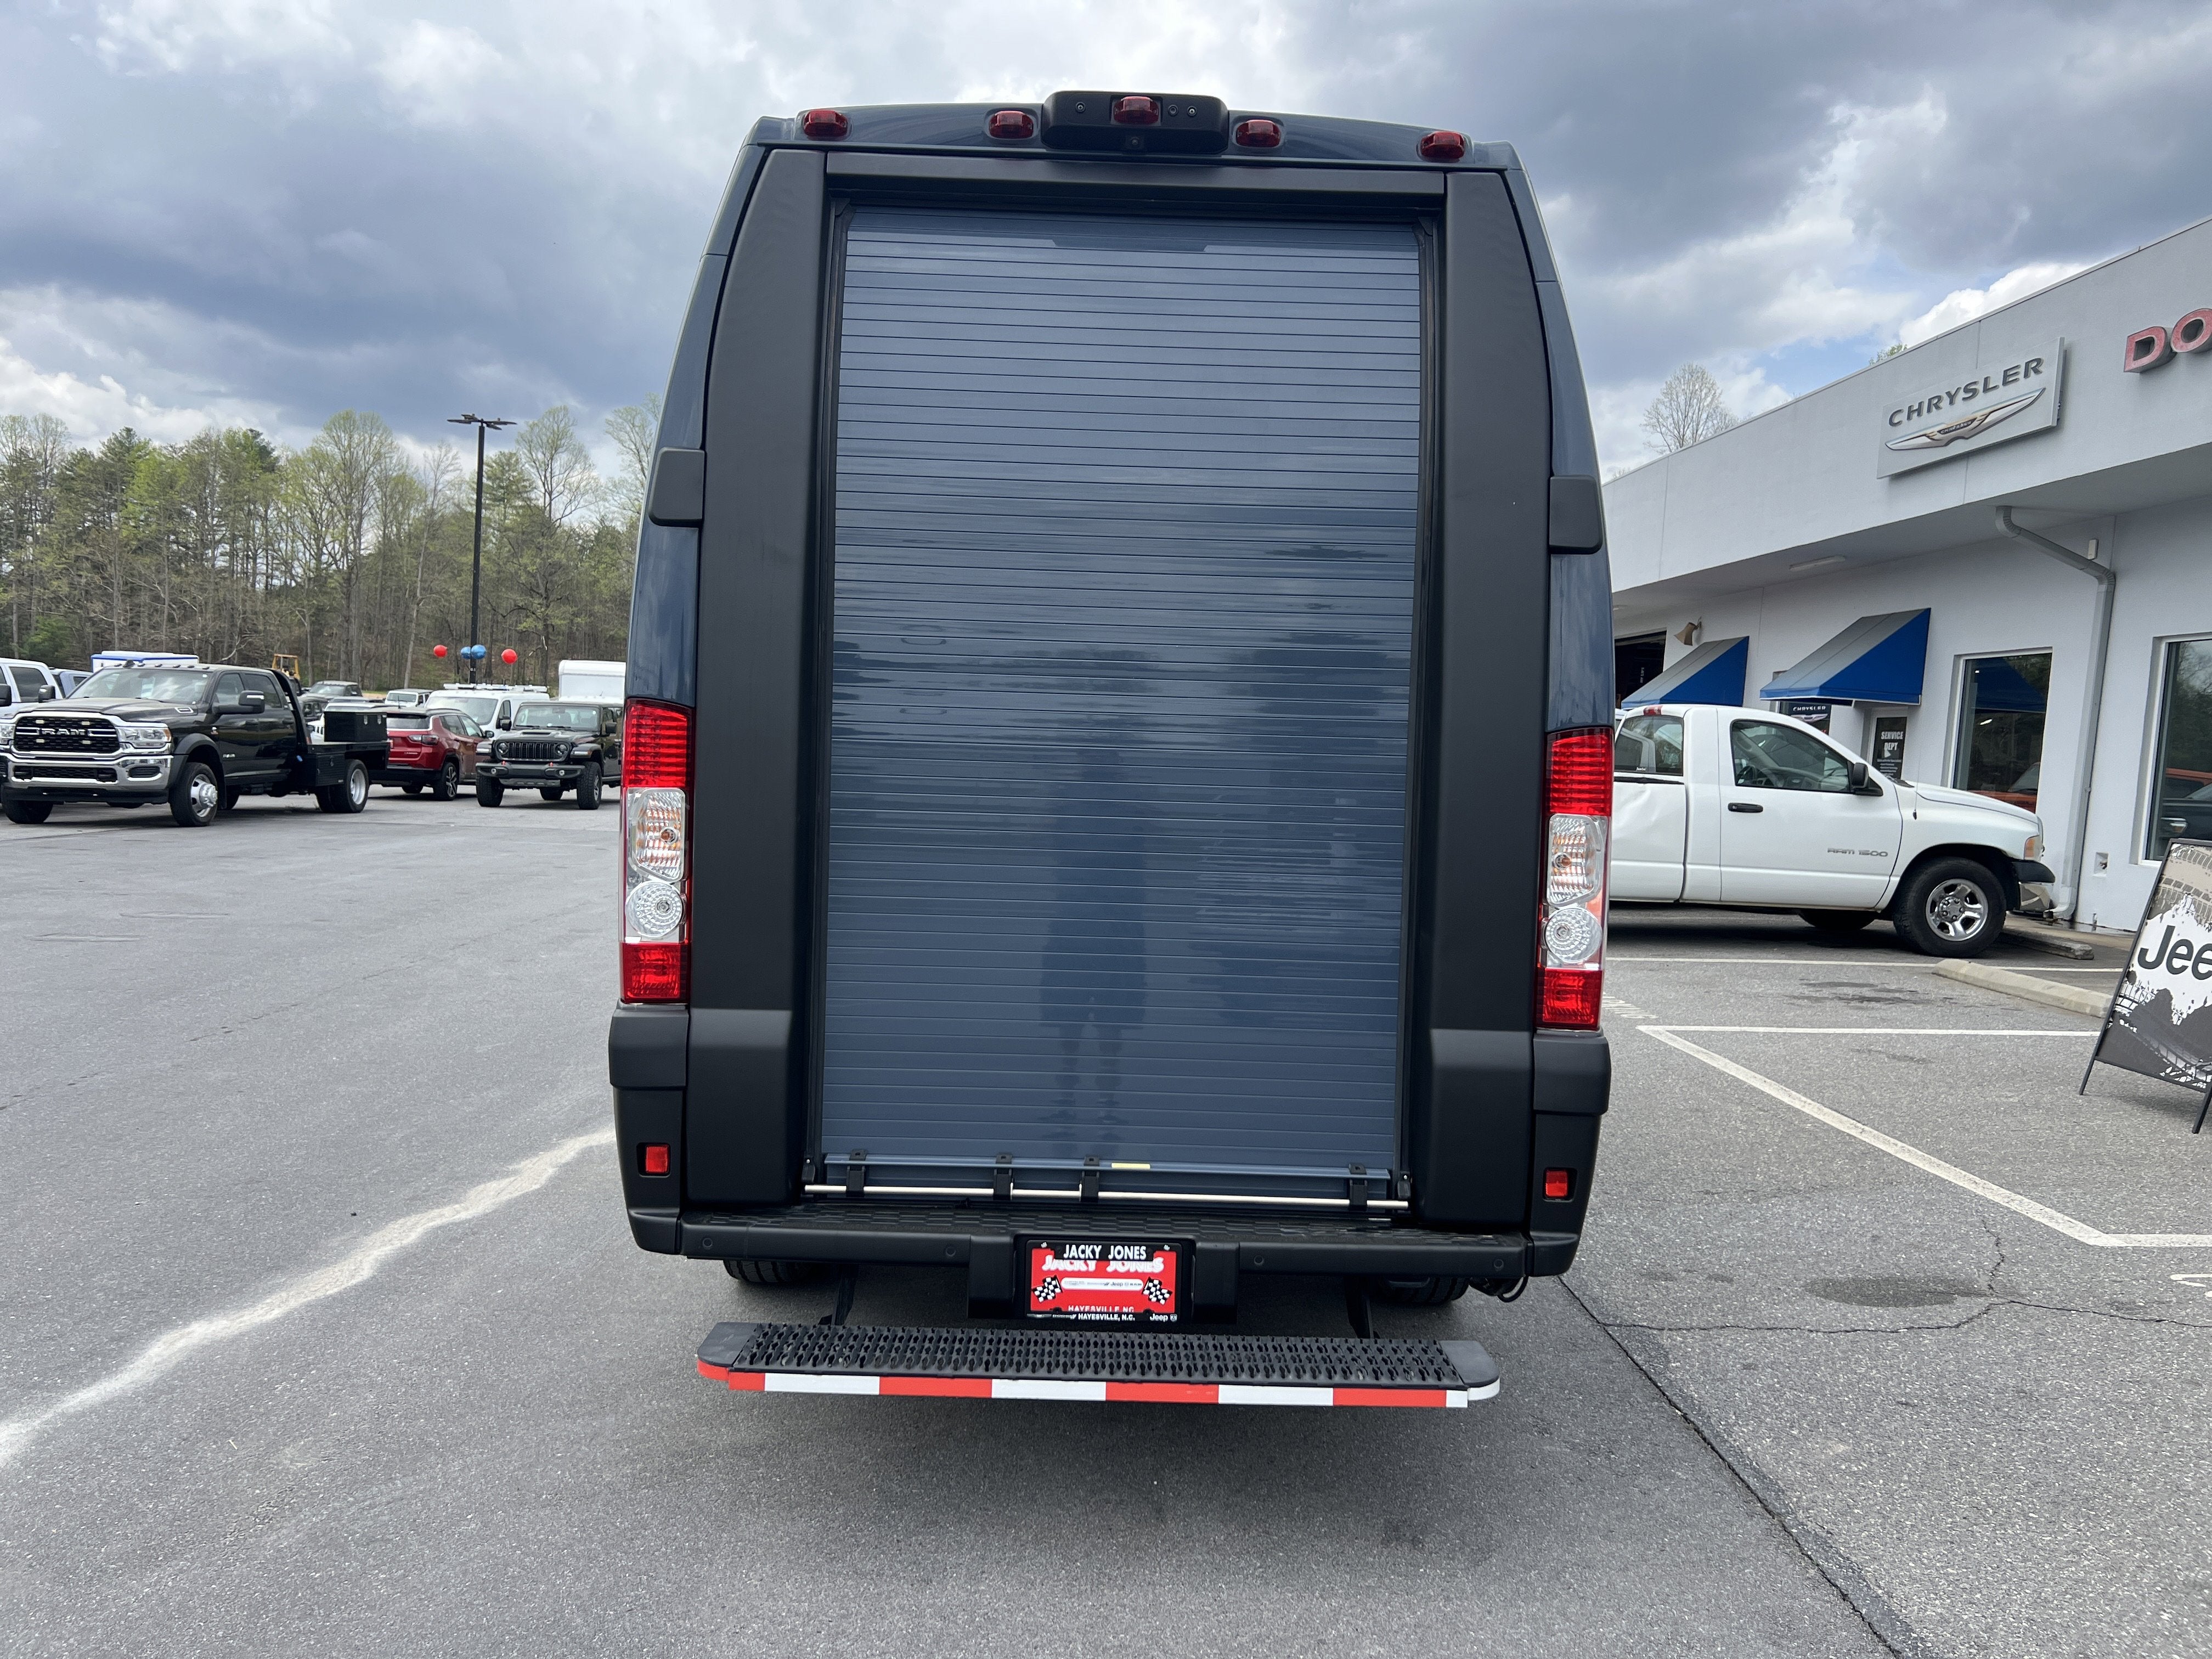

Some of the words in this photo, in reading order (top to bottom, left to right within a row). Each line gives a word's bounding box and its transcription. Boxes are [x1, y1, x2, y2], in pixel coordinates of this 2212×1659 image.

[1889, 358, 2044, 427] CHRYSLER
[1881, 731, 1904, 740] SERVICE
[1884, 742, 1898, 751] DEPT
[1063, 1244, 1102, 1259] JACKY
[1108, 1245, 1147, 1260] JONES
[1042, 1255, 1097, 1272] JACKY
[1106, 1257, 1164, 1273] JONES
[1078, 1313, 1120, 1322] HAYESVILLE,
[1150, 1313, 1168, 1322] Jeep
